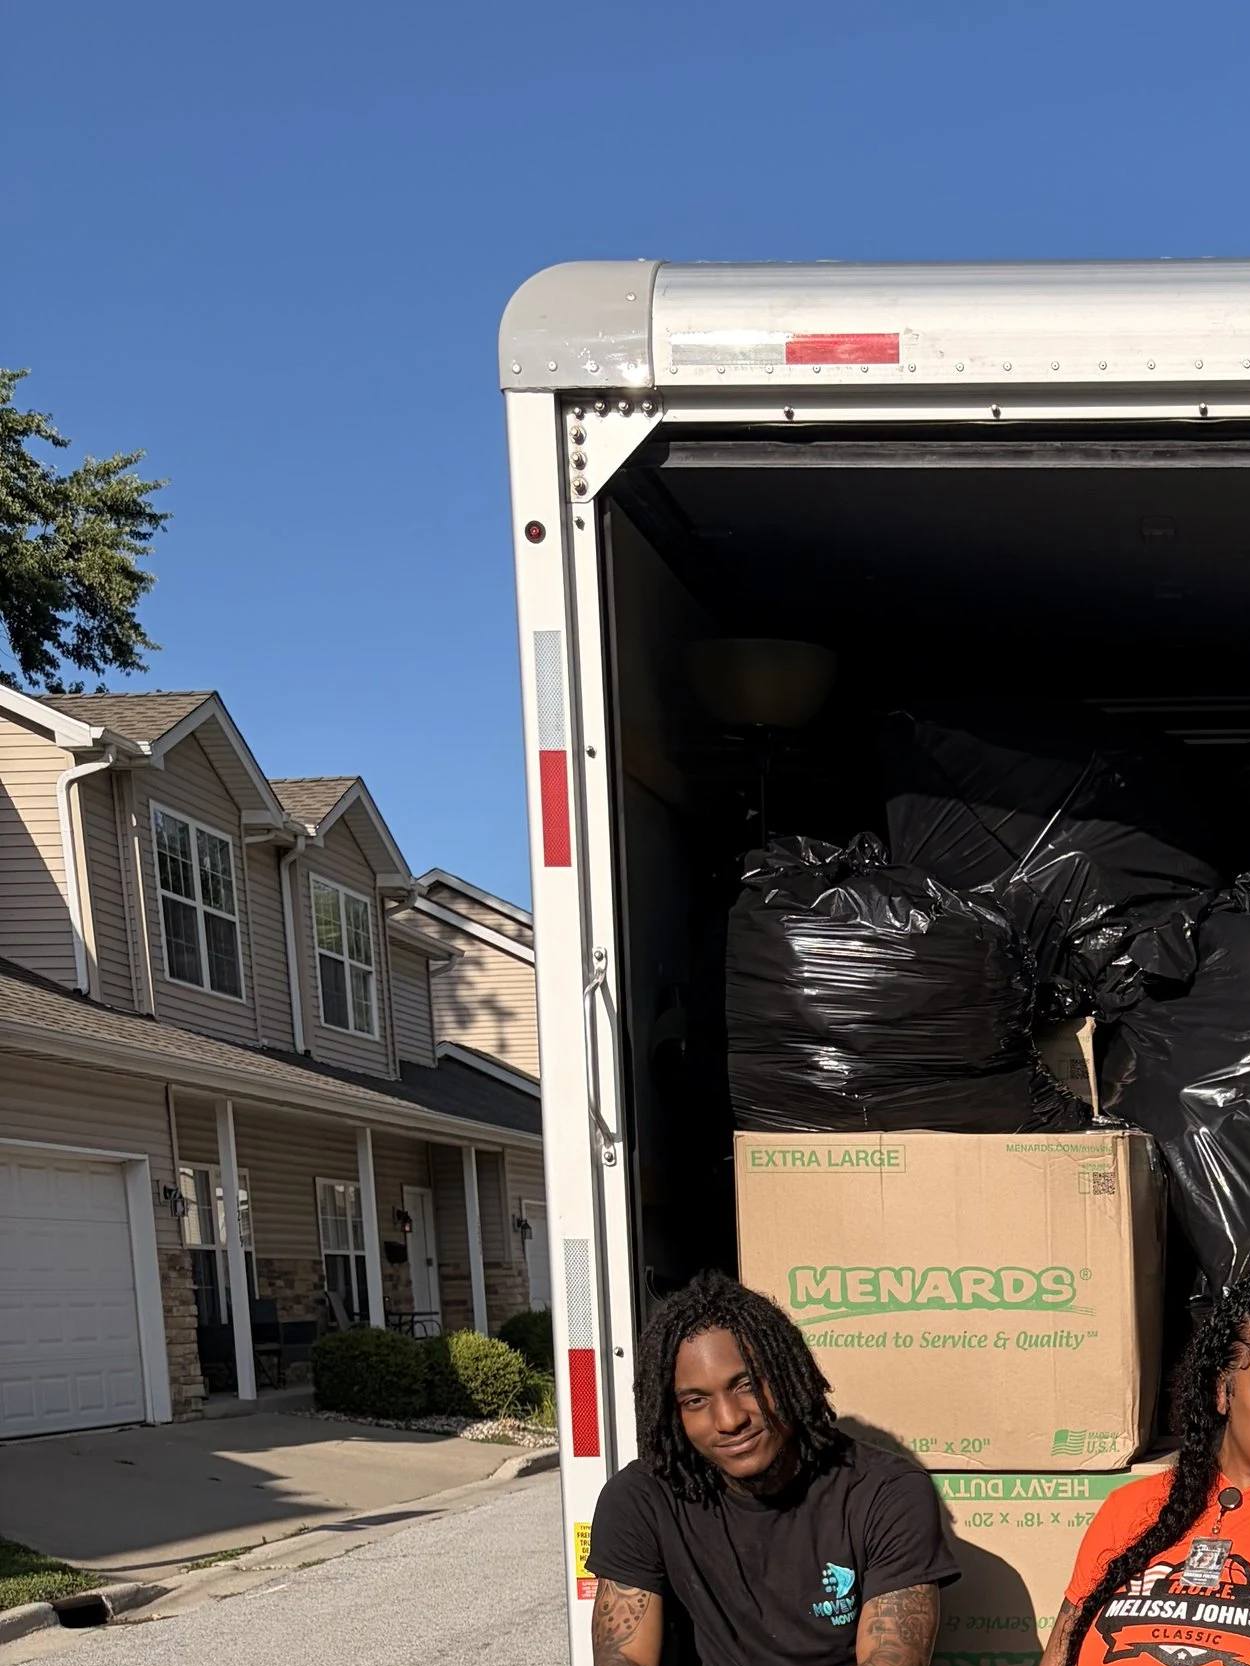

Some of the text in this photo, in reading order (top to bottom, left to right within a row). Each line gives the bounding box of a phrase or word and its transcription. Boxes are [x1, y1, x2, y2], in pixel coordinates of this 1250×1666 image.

[751, 1150, 901, 1167] EXTRA LARGE
[789, 1266, 1078, 1310] MENARDS
[893, 1333, 914, 1348] to
[920, 1331, 988, 1348] Service
[994, 1331, 1009, 1349] &
[1015, 1331, 1085, 1350] Quality
[1088, 1431, 1109, 1439] MADE
[944, 1440, 954, 1453] x
[960, 1438, 990, 1453] 20"
[1087, 1440, 1120, 1453] U.S.A.
[942, 1478, 1090, 1498] HEAVY DUTY
[964, 1512, 994, 1528] 20"
[999, 1512, 1010, 1524] x
[1016, 1512, 1044, 1527] 18"
[1050, 1512, 1060, 1523] x
[1105, 1599, 1188, 1620] MELISSA
[966, 1616, 1032, 1633] Service
[1151, 1628, 1223, 1645] CLASSIC
